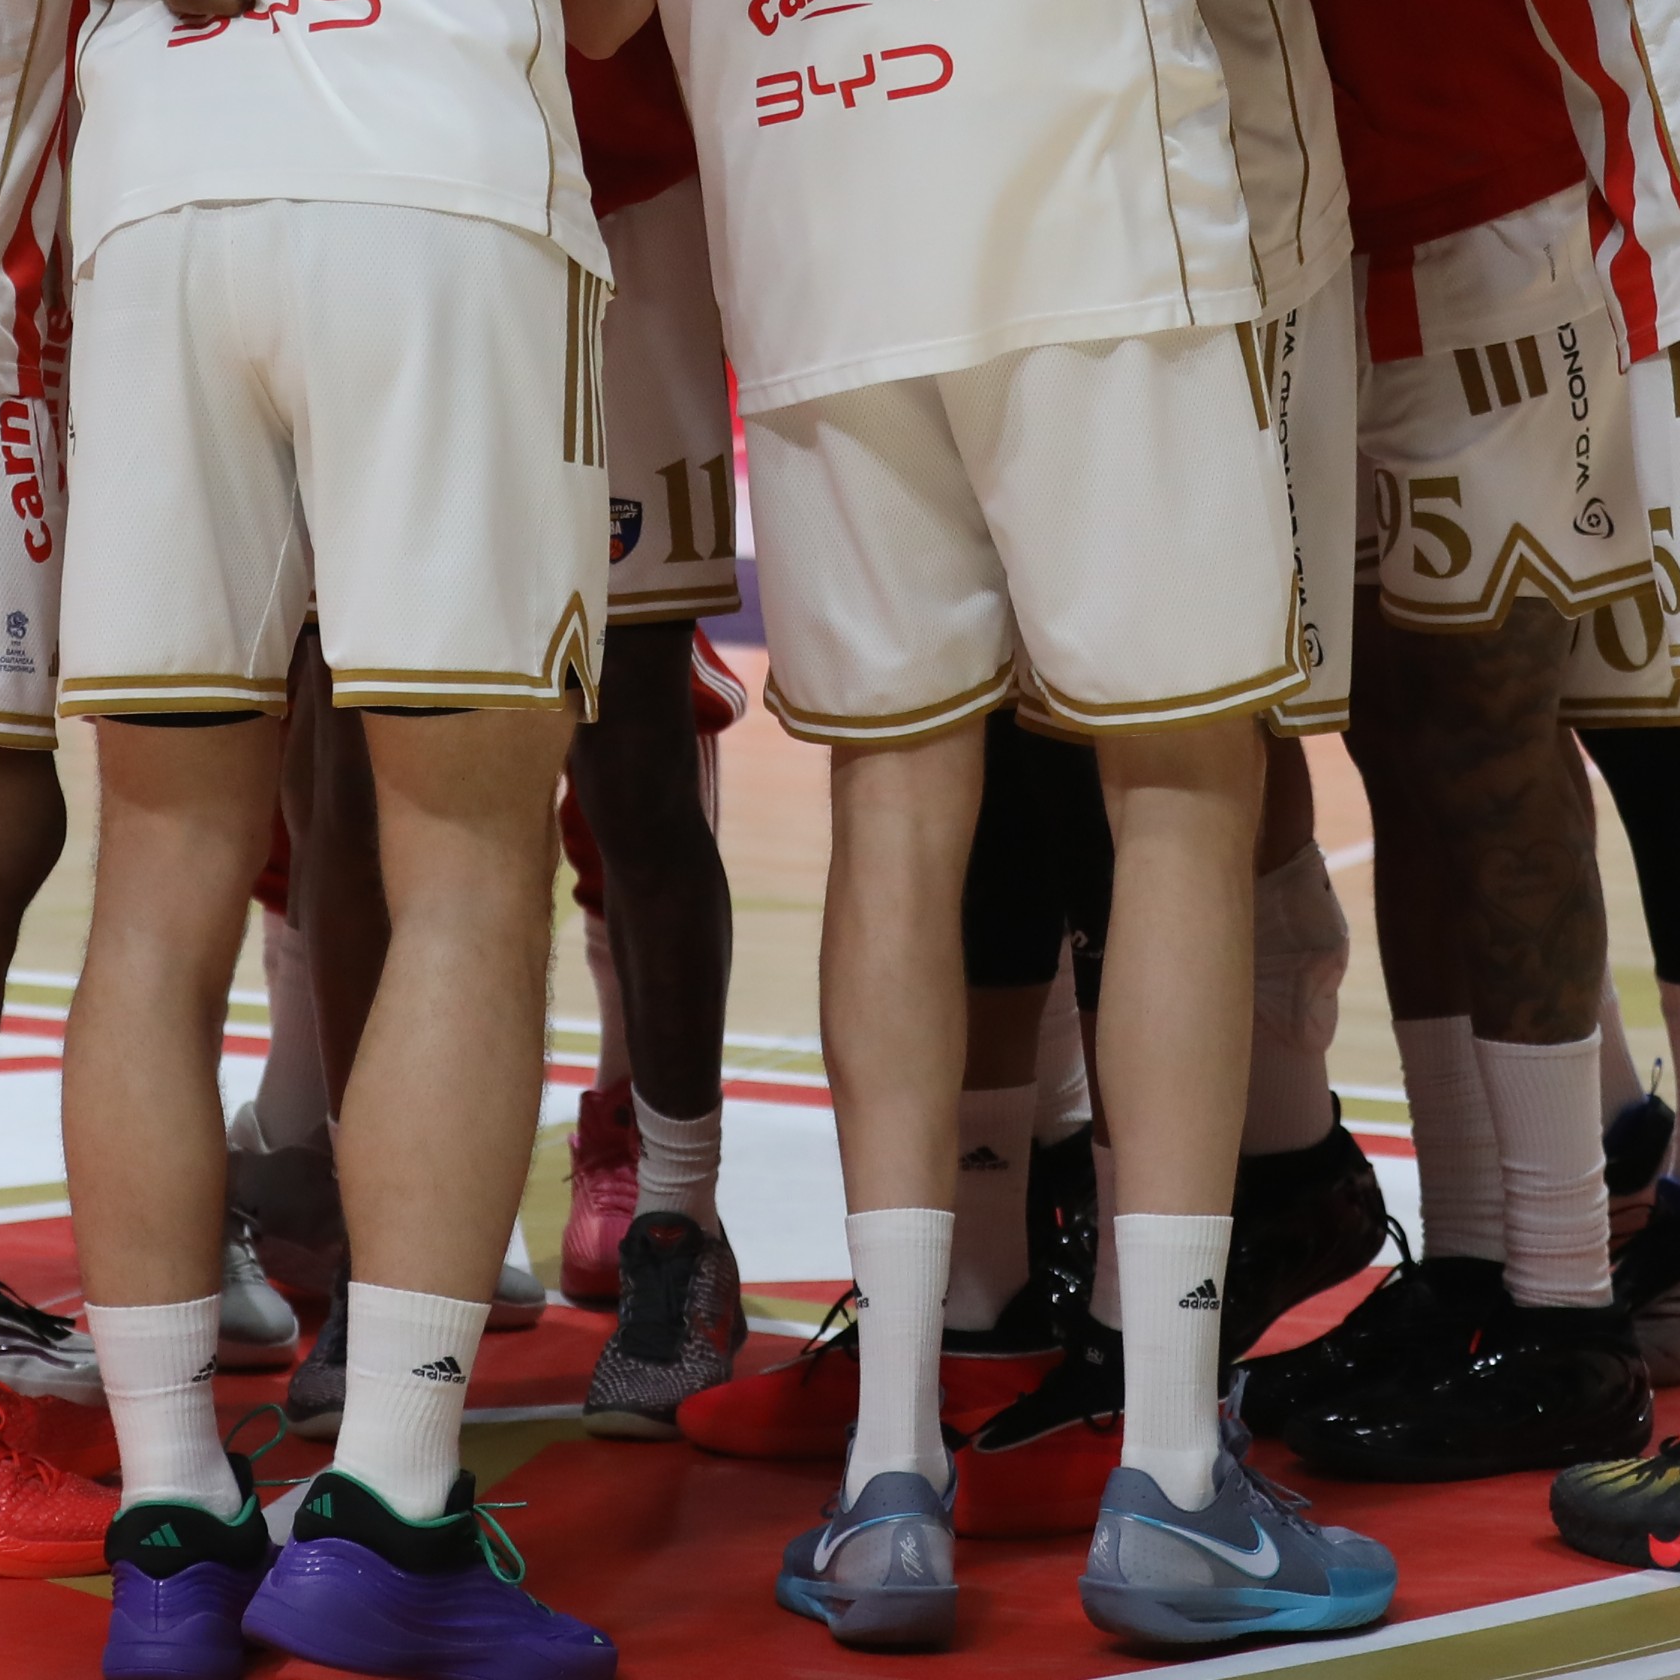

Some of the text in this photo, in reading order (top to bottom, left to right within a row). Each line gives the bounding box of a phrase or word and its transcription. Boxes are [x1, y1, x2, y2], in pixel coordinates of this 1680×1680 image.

[755, 43, 954, 128] BYD
[1179, 1297, 1220, 1310] adidas
[412, 1368, 467, 1385] adidas
